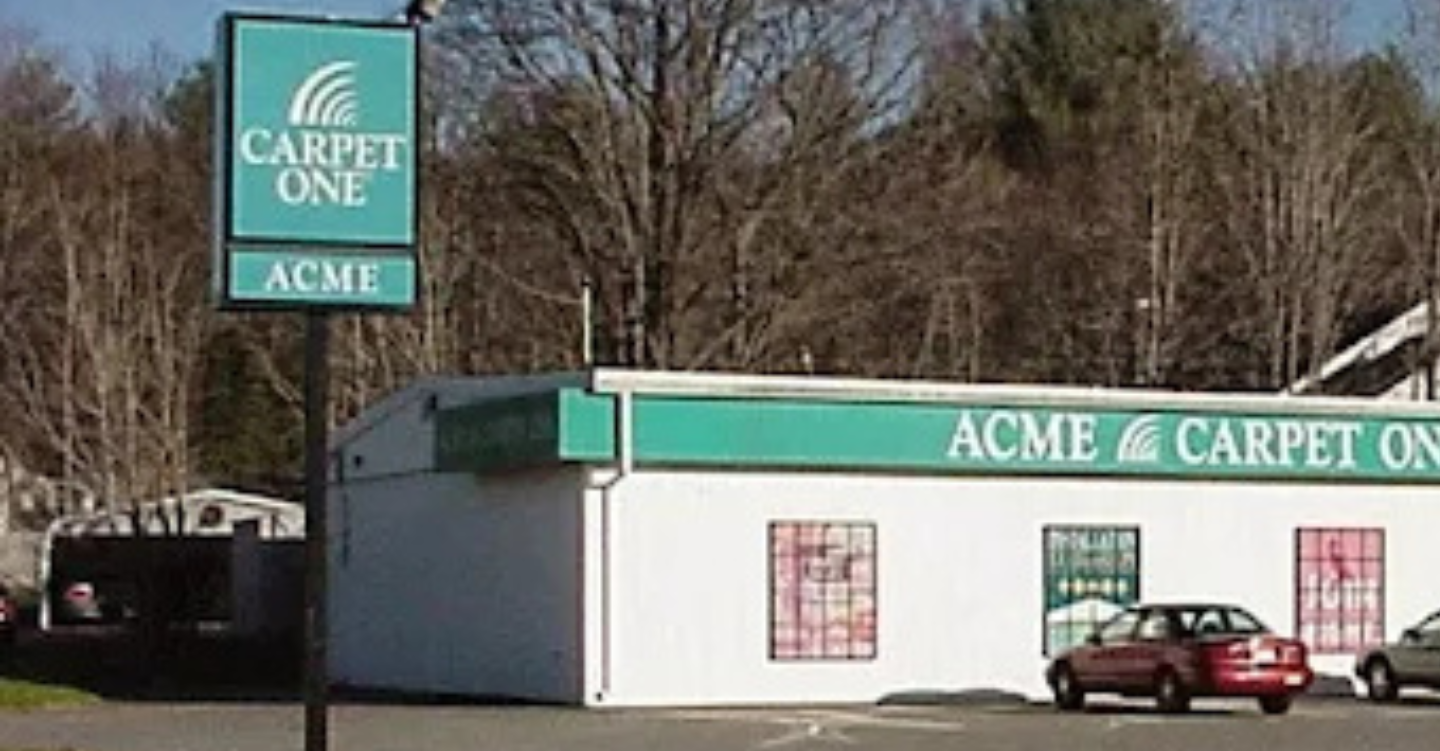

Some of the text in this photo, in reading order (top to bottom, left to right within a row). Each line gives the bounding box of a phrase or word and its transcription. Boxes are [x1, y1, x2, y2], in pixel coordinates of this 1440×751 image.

[239, 129, 406, 170] CARPET
[276, 167, 367, 206] ONE
[264, 258, 379, 293] ACME
[946, 411, 1098, 462] ACME
[1176, 417, 1363, 469] CARPET
